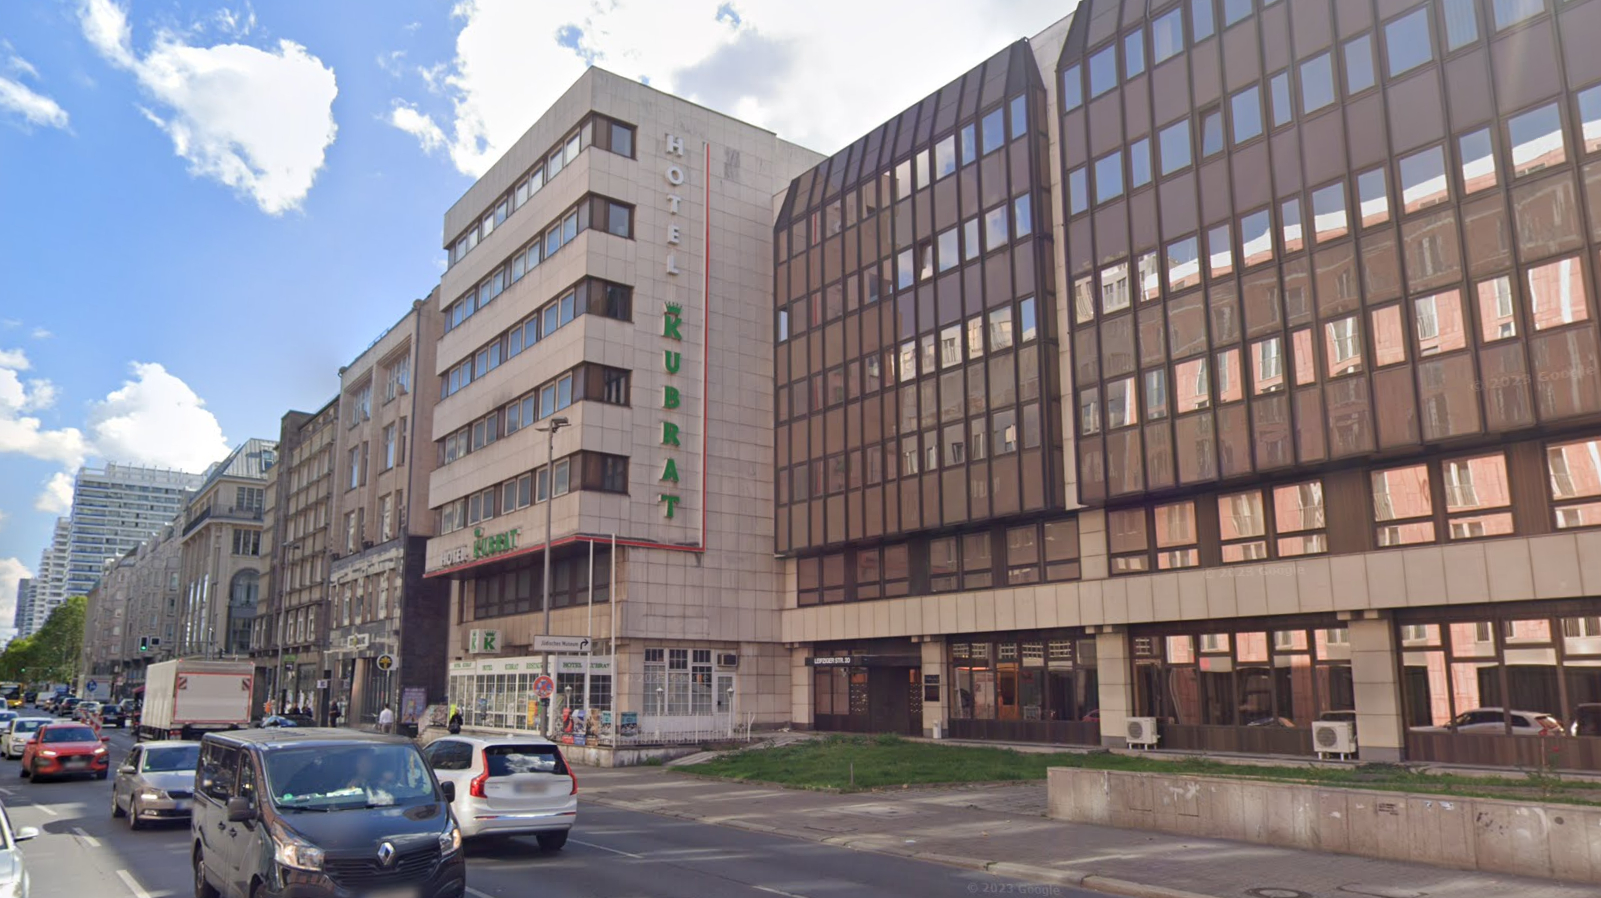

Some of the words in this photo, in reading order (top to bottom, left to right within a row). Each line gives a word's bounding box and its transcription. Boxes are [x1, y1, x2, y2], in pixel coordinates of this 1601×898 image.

[665, 133, 684, 276] HOTEL
[659, 314, 683, 519] KUBRAT
[441, 546, 469, 567] HOTEL
[473, 528, 521, 559] KUBRAT
[483, 637, 497, 650] K
